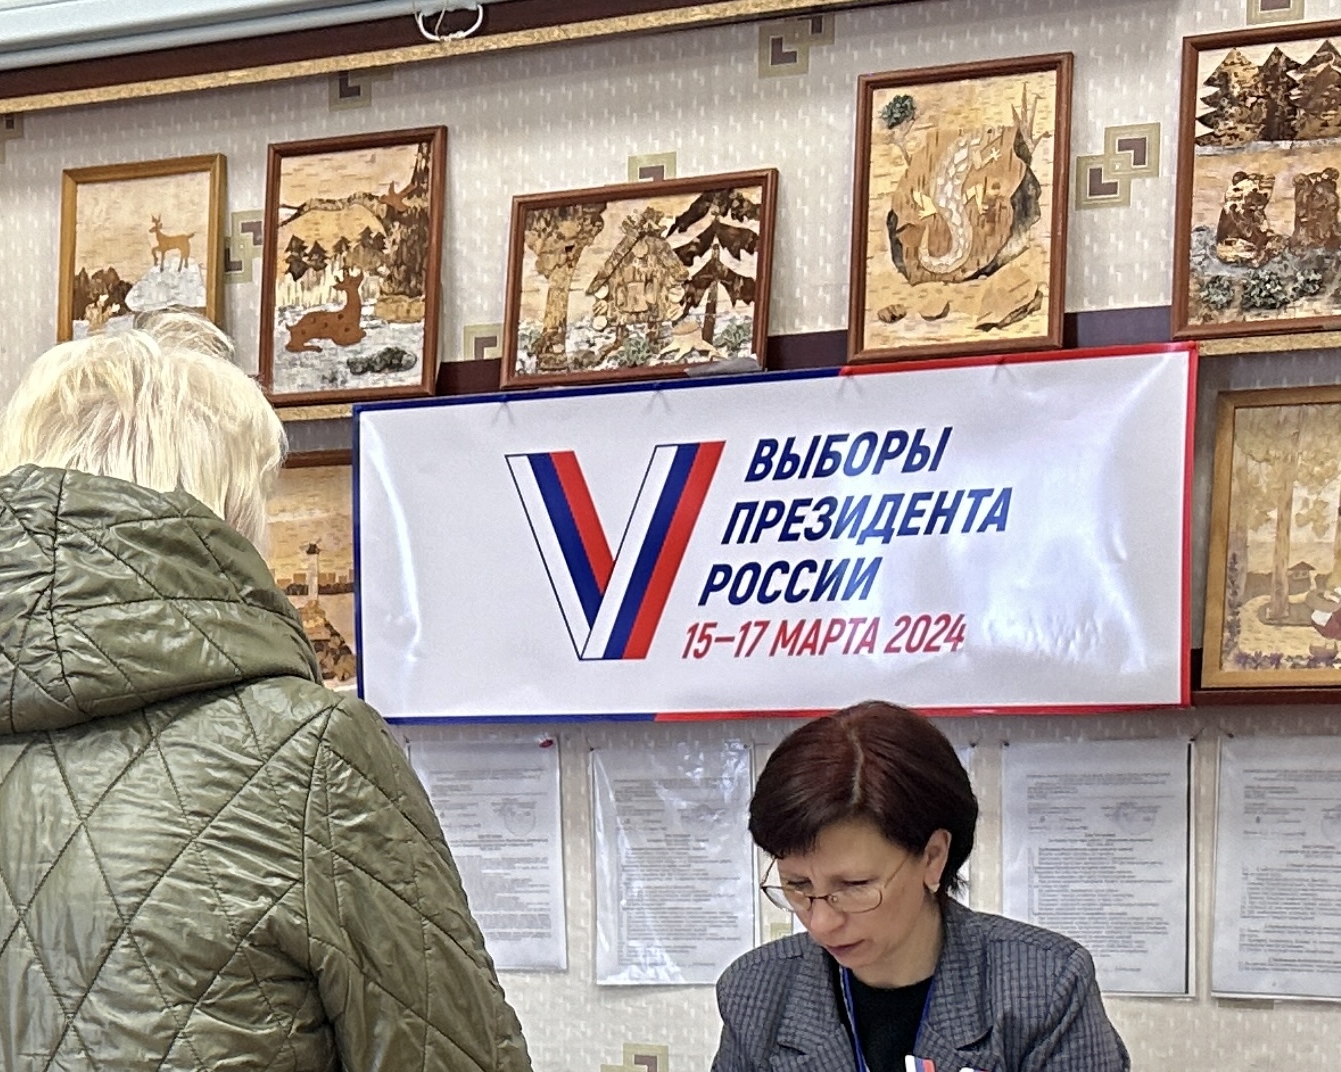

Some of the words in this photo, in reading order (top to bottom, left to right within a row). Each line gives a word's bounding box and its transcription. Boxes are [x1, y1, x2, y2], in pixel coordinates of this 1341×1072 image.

[744, 426, 953, 483] ВЫБОРЫ
[721, 486, 1013, 546] ПРЕЗИДЕНТА
[698, 556, 883, 607] РОССИИ
[769, 616, 881, 657] МАРТА
[883, 613, 967, 654] 2024
